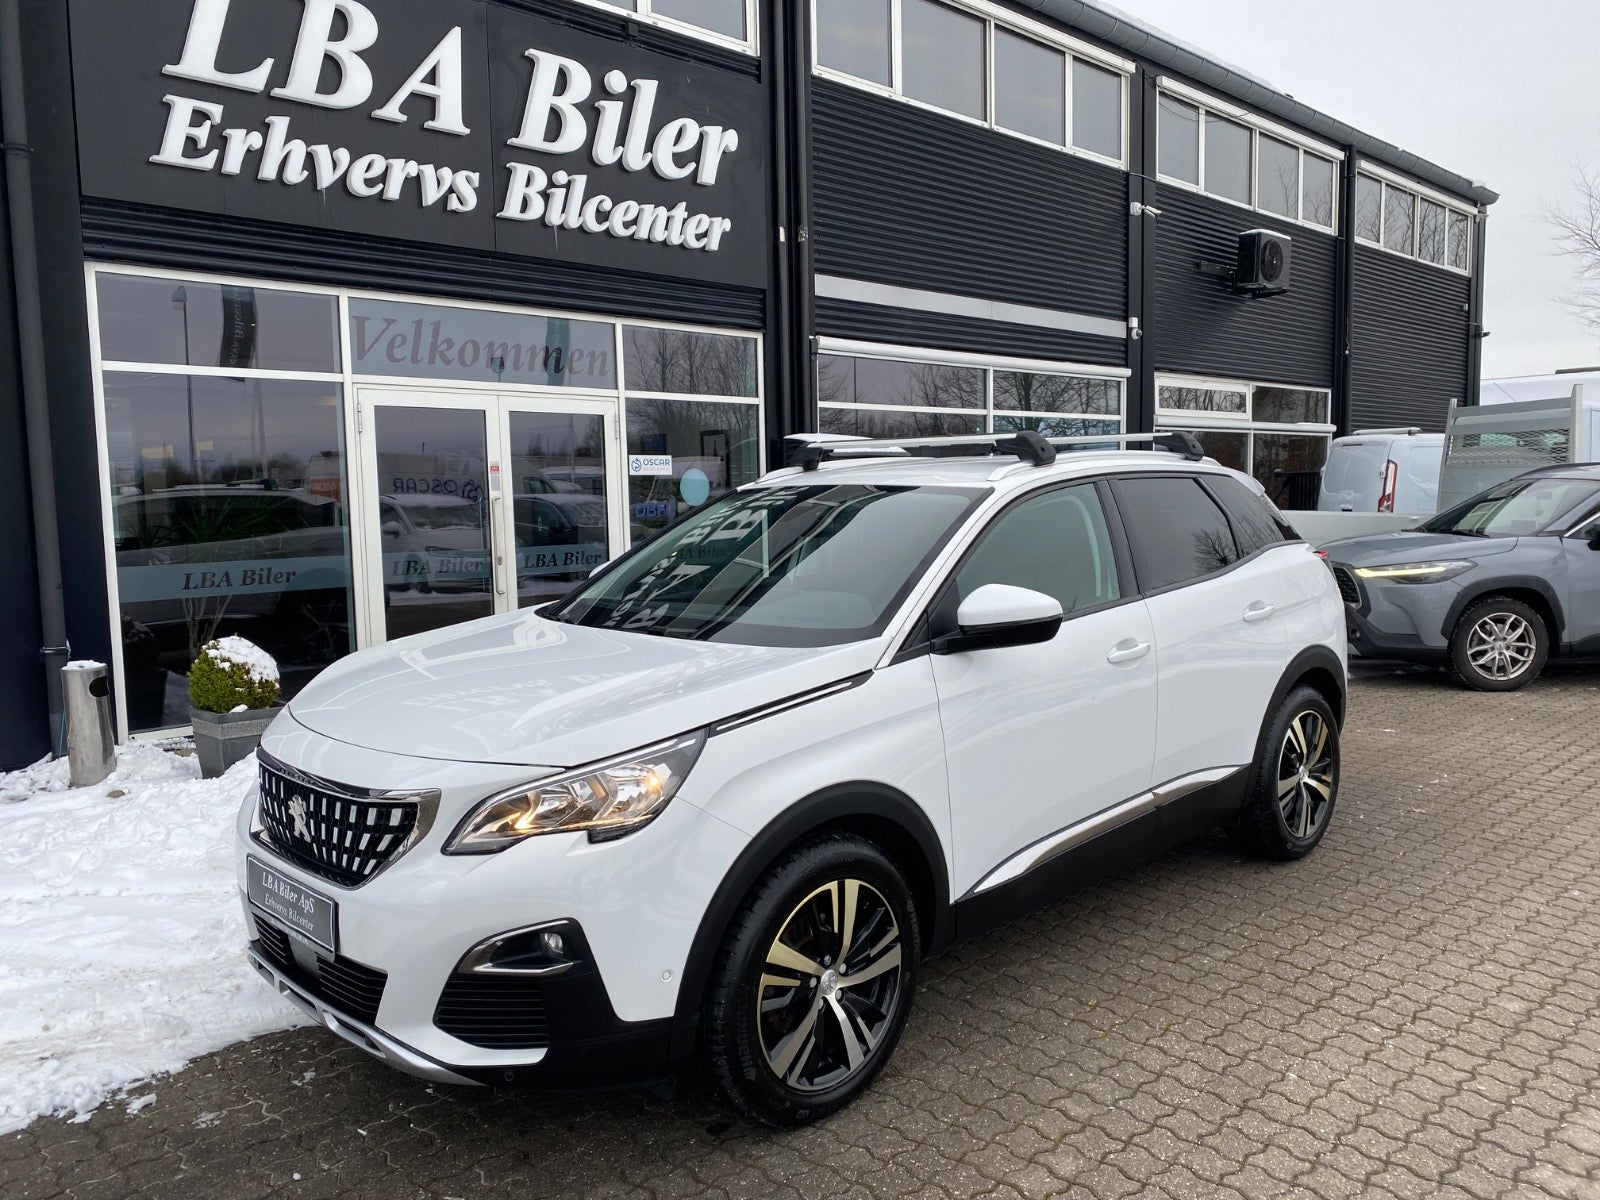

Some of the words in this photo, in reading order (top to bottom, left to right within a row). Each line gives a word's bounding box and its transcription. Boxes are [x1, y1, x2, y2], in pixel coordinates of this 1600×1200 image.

[161, 0, 471, 136] LBA
[506, 48, 739, 186] Biler
[149, 94, 480, 213] Erhvervs
[496, 161, 731, 251] Bilcenter
[351, 315, 609, 377] Velkommen
[643, 458, 670, 466] OSCAR
[391, 558, 432, 577] LBA
[438, 557, 484, 574] Biler
[524, 553, 558, 569] LBA
[563, 551, 602, 566] Biler
[182, 571, 234, 590] LBA
[240, 567, 297, 587] Biler
[262, 872, 279, 891] LBA
[279, 884, 298, 903] Biler
[298, 893, 315, 914] ApS
[288, 907, 314, 931] Bilcenter
